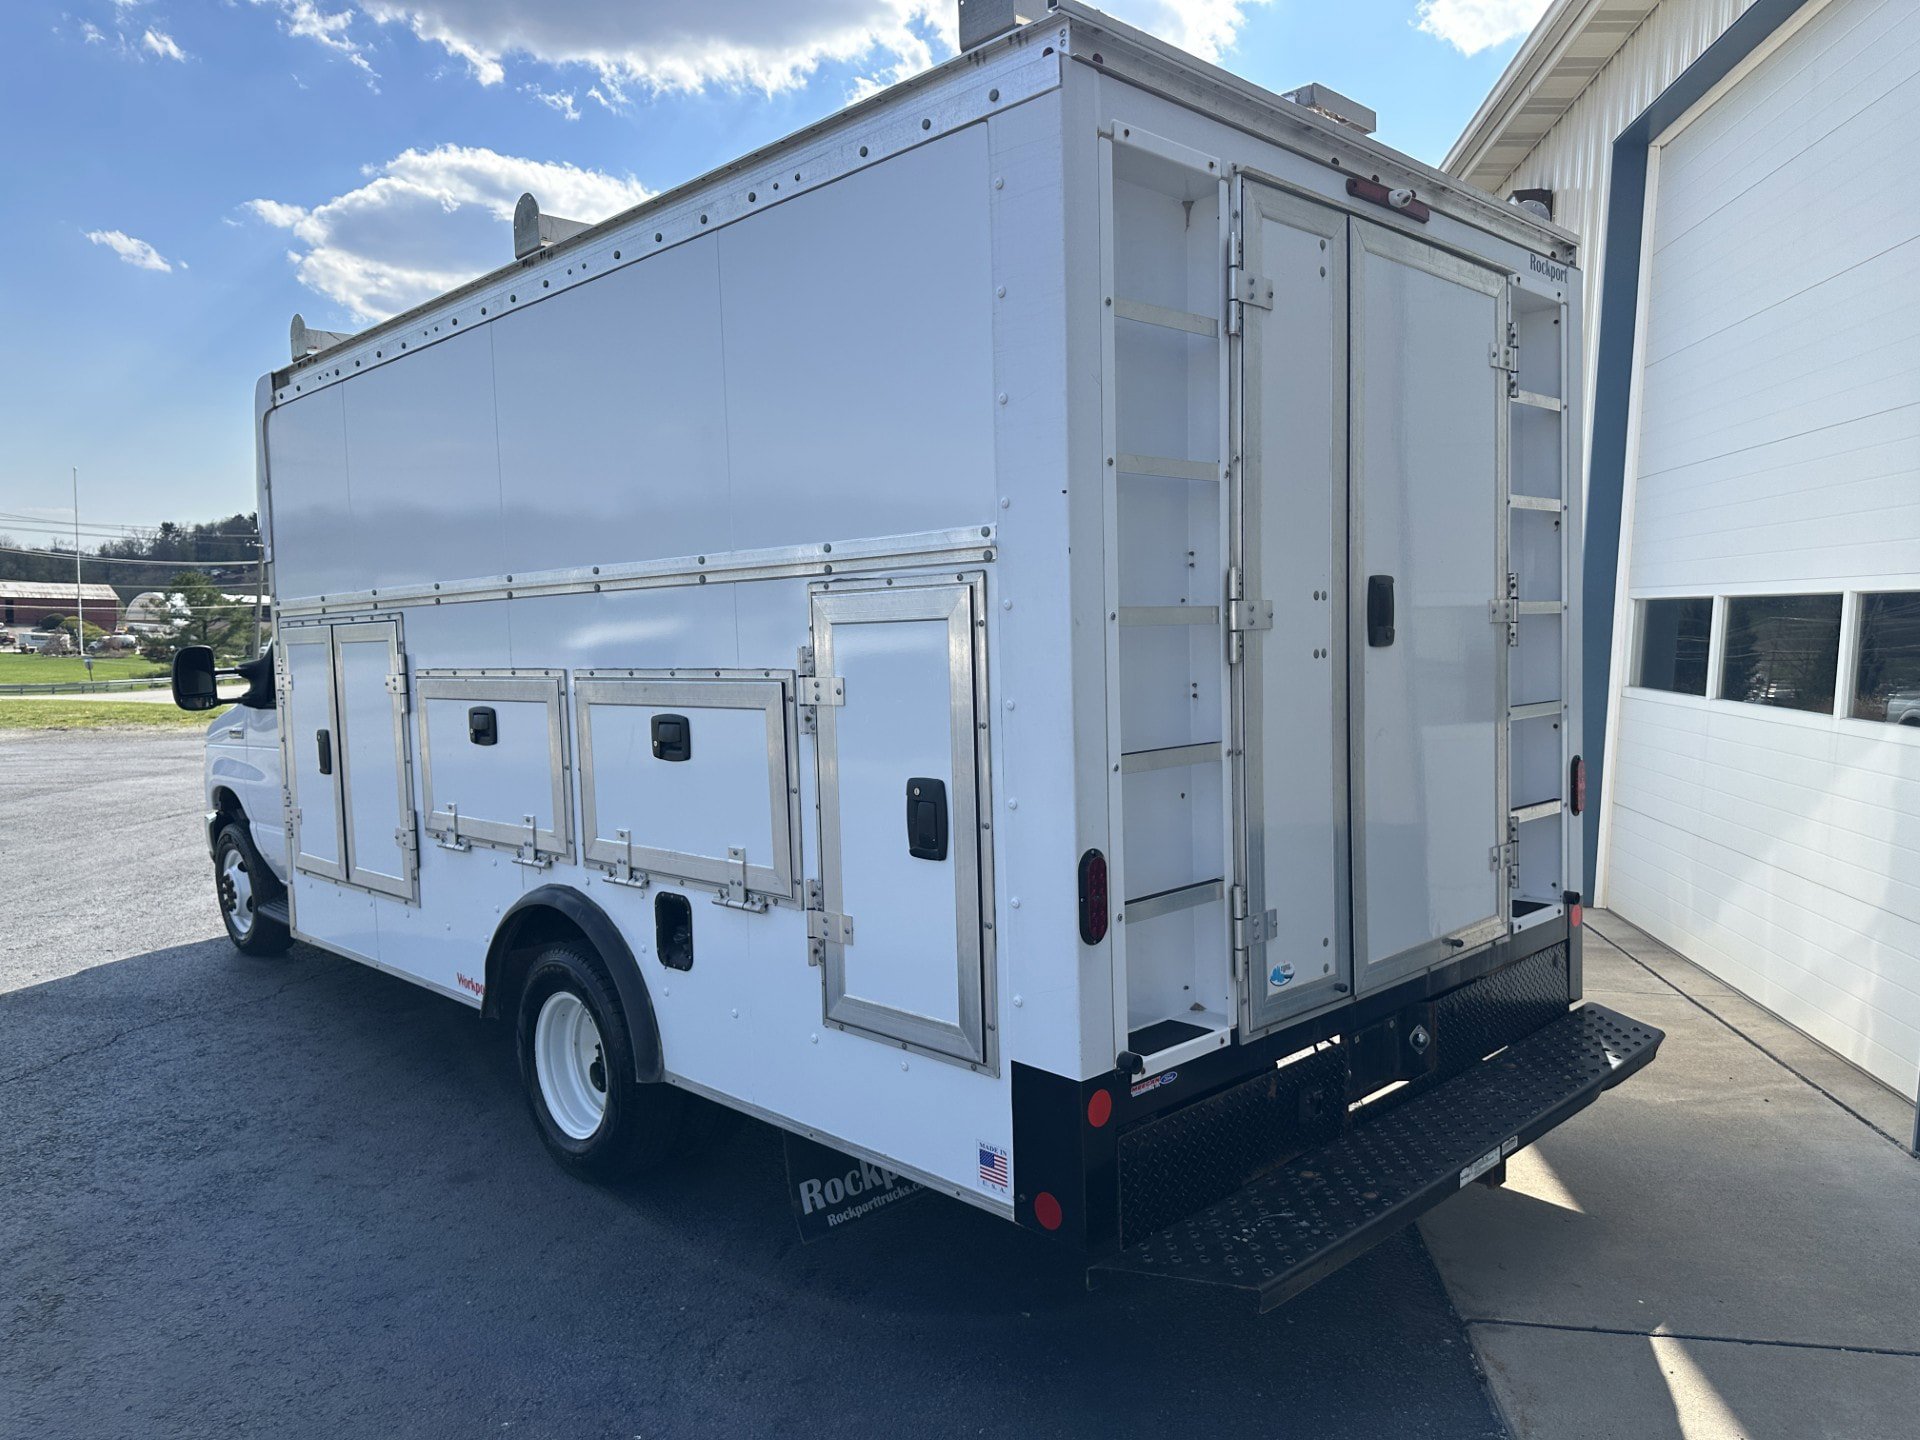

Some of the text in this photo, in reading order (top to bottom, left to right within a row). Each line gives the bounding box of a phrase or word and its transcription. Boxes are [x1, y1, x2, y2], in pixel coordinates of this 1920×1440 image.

[1529, 253, 1568, 283] Rockport
[980, 1142, 1007, 1157] MADE IN
